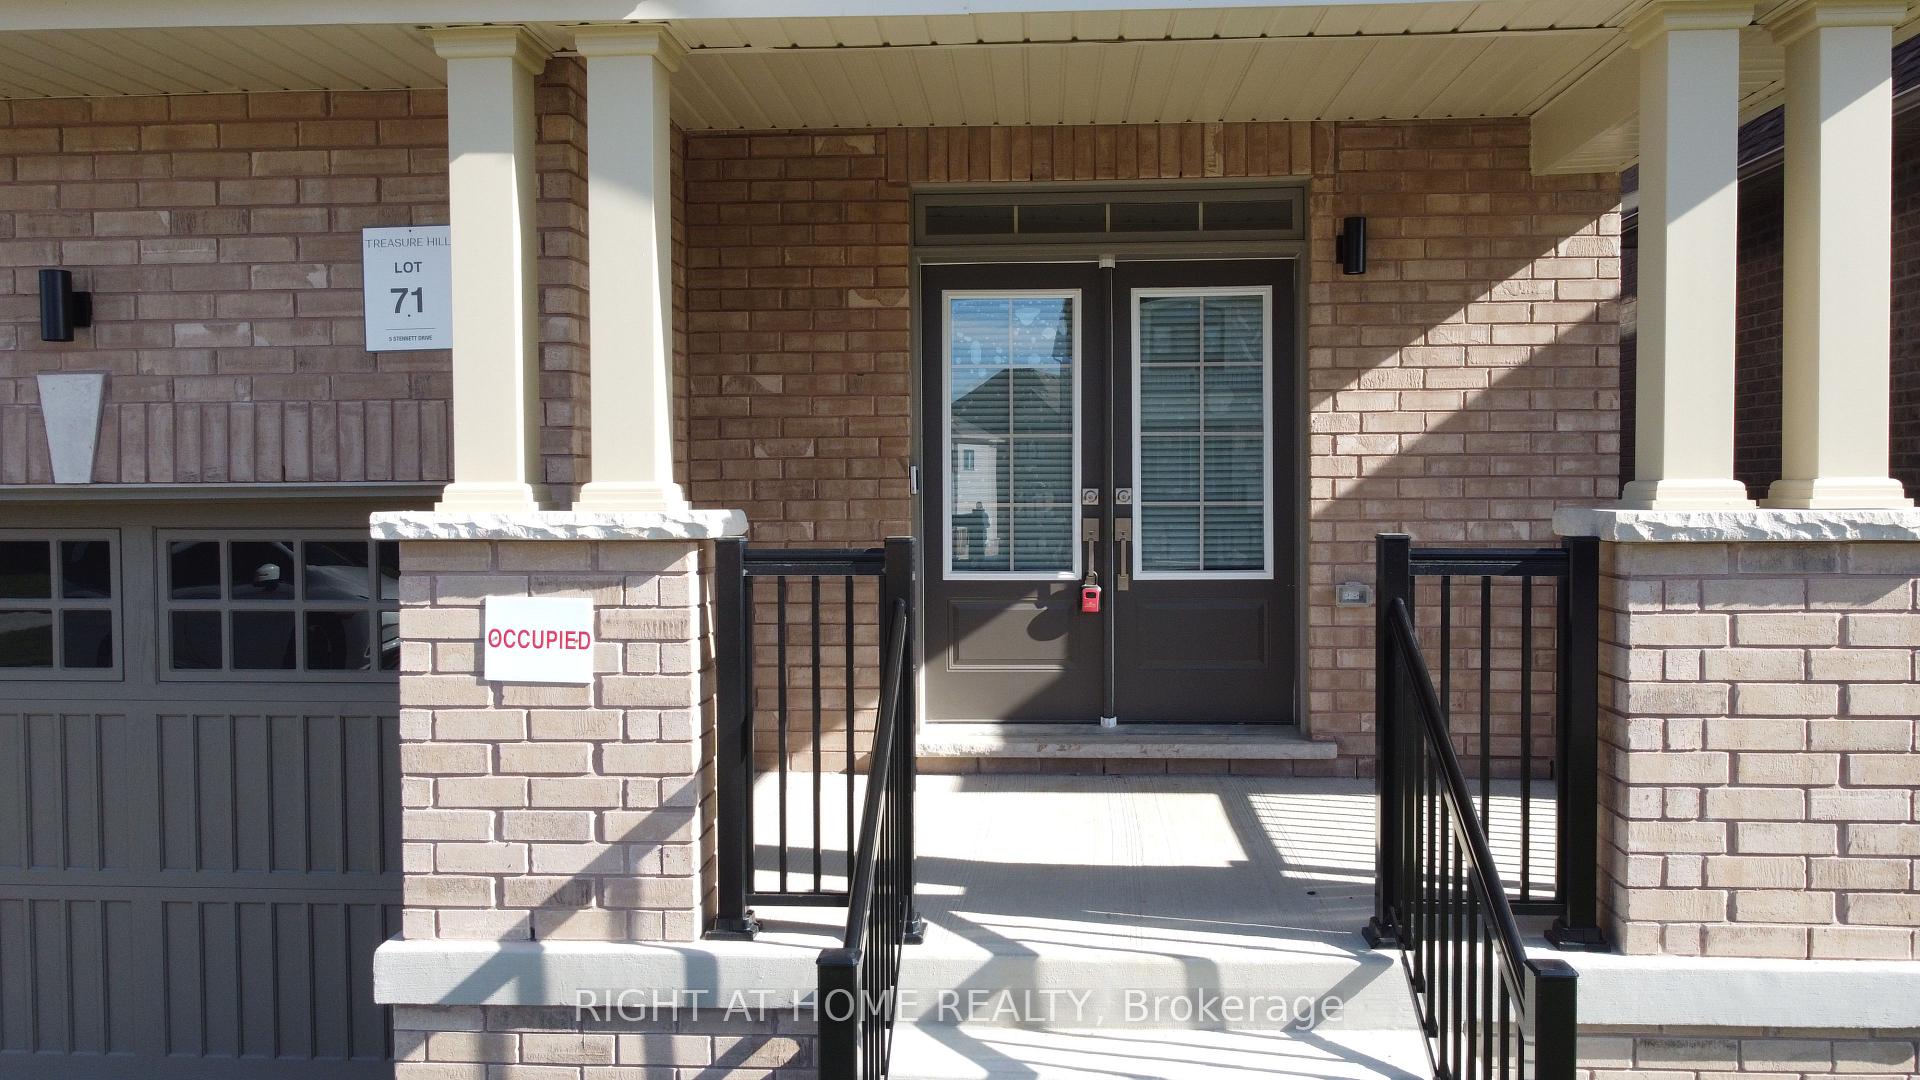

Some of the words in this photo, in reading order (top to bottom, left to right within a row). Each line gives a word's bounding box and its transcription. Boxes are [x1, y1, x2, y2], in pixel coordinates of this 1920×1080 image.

[365, 237, 424, 249] TREASURE
[427, 236, 452, 247] HILL
[394, 261, 423, 274] LOT
[390, 286, 423, 314] 71
[488, 628, 591, 650] OCCUPIED
